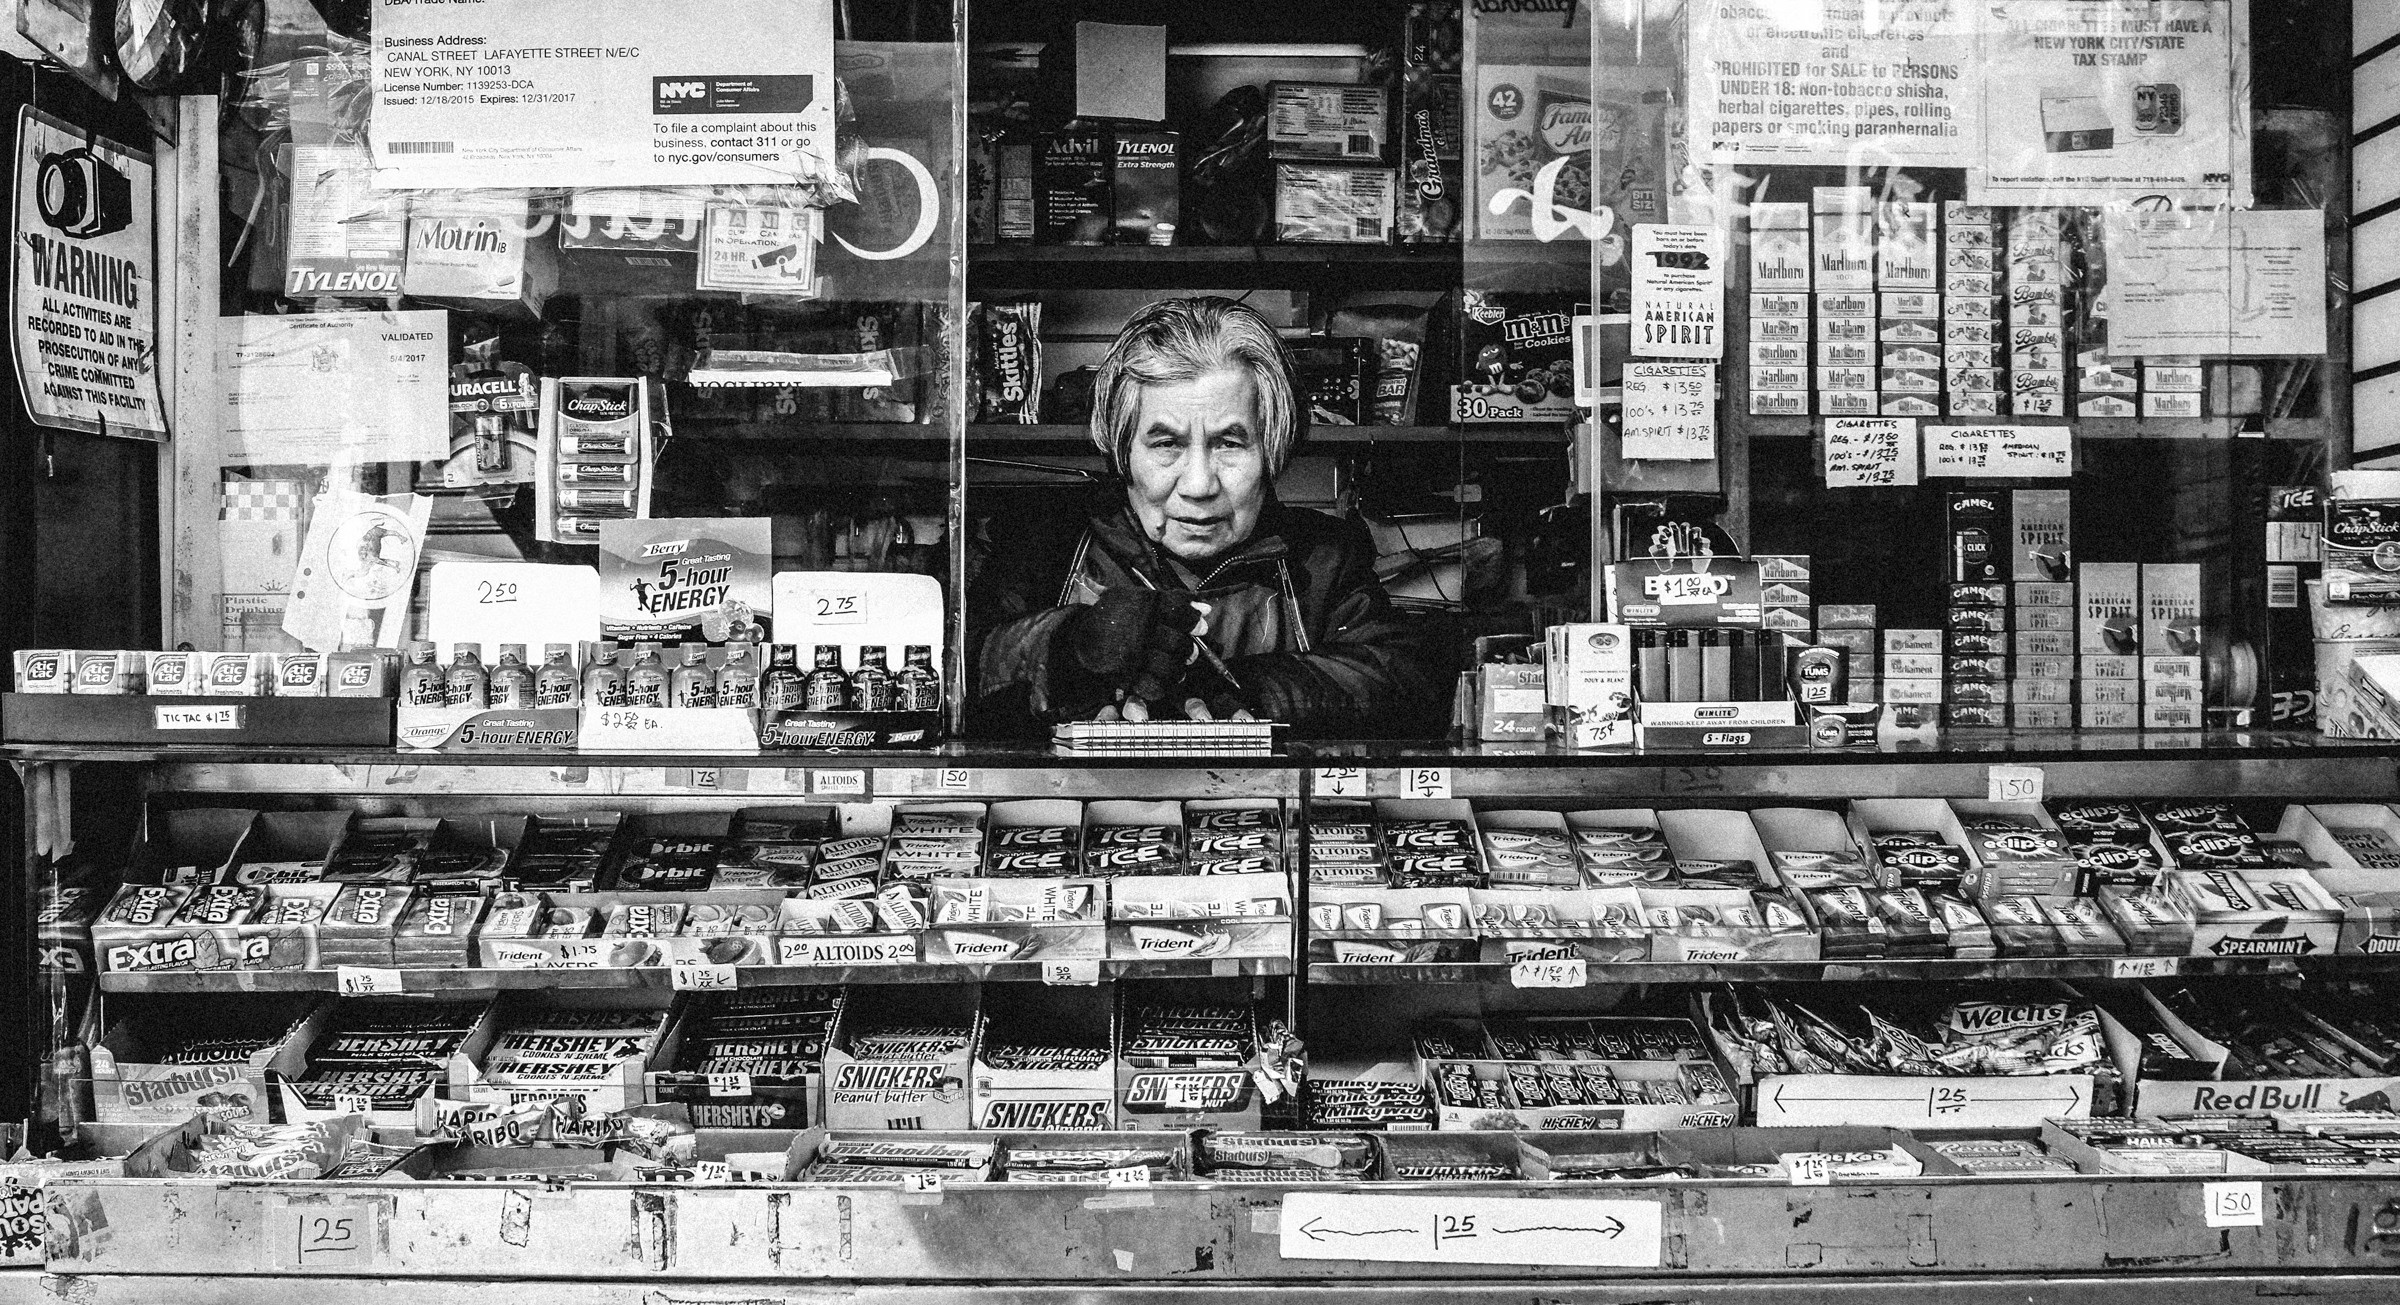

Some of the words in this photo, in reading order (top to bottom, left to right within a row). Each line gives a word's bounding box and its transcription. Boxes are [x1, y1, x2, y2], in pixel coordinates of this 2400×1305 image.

[2121, 20, 2161, 33] MUST
[2165, 20, 2199, 33] HAVE
[384, 37, 434, 47] Business
[436, 35, 487, 46] Address:
[2034, 37, 2065, 50] NEW
[2069, 36, 2105, 50] YORK
[2109, 36, 2185, 50] CITY/STATE
[387, 51, 428, 63] CANAL
[431, 50, 478, 61] STREET
[484, 49, 552, 60] LAFAYETTE
[555, 48, 603, 59] STREET
[605, 47, 640, 58] N/E/C
[2073, 53, 2097, 66] TAX
[2101, 53, 2148, 66] STAMP
[384, 67, 412, 78] NEW
[415, 66, 453, 78] YORK,
[456, 66, 474, 76] NY
[477, 65, 511, 75] 10013
[1713, 61, 1801, 76] PROHIBITED
[1830, 64, 1866, 78] SALE
[1892, 64, 1959, 80] PERSONS
[383, 83, 420, 92] License
[423, 82, 464, 91] Number:
[467, 80, 534, 90] 1139253-DCA
[660, 82, 706, 99] NYC
[1720, 80, 1770, 95] UNDER
[1773, 80, 1796, 96] 18:
[1800, 82, 1893, 98] Non-tobacco
[1896, 84, 1949, 100] shisha,
[383, 97, 418, 106] Issued:
[420, 95, 475, 105] 12/18/2015
[480, 94, 519, 106] Expires:
[522, 93, 576, 103] 12/31/2017
[1492, 90, 1517, 108] 42
[1718, 100, 1764, 115] herbal
[1769, 101, 1849, 118] cigarettes,
[1855, 103, 1900, 120] pipes,
[1904, 103, 1952, 120] rolling
[653, 123, 668, 133] To
[671, 122, 688, 133] file
[690, 125, 699, 133] a
[701, 122, 757, 135] complaint
[760, 122, 793, 132] about
[796, 122, 817, 132] this
[1712, 121, 1763, 136] papers
[1786, 120, 1850, 138] smoking
[1855, 121, 1958, 138] paraphernalia
[653, 137, 707, 149] business,
[710, 137, 754, 148] contact
[756, 136, 777, 147] 311
[781, 139, 793, 147] or
[795, 138, 811, 150] go
[1047, 138, 1100, 154] Advil
[1116, 139, 1176, 155] TYLENOL
[653, 152, 665, 163] to
[668, 151, 780, 165] nyc.gov/consumers
[1417, 109, 1446, 200] Grandma's
[1117, 160, 1138, 169] Extra
[1140, 160, 1176, 169] Strength
[2203, 173, 2230, 184] NYC
[416, 219, 500, 254] Motrin
[1758, 258, 1804, 280] Marlboro
[1821, 253, 1868, 272] Marlboro
[31, 232, 139, 312] WARNING
[291, 266, 399, 294] TYLENOL
[42, 297, 60, 314] ALL
[63, 301, 112, 327] ACTIVITIES
[114, 314, 132, 330] ARE
[1473, 307, 1504, 321] Keebler
[1645, 301, 1714, 311] NATURAL
[1645, 310, 1715, 323] AMERICAN
[28, 315, 82, 340] RECORDED
[84, 327, 97, 343] TO
[100, 330, 115, 347] AID
[116, 334, 126, 349] IN
[128, 336, 146, 353] THE
[381, 332, 434, 342] VALIDATED
[1525, 334, 1571, 349] Cookies
[1645, 324, 1714, 345] SPIRIT
[38, 339, 105, 365] PROSECUTION
[107, 351, 119, 367] OF
[121, 355, 139, 372] ANY
[389, 354, 427, 363] 5/4/2017
[1002, 320, 1022, 402] Skittles
[47, 361, 79, 381] CRIME
[81, 367, 135, 390] COMMITTED
[1634, 366, 1707, 377] CIGARETTES
[43, 381, 84, 402] AGAINST
[85, 388, 107, 406] THIS
[109, 392, 147, 411] FACILITY
[567, 399, 628, 413] ChapStick
[1458, 398, 1488, 418] 30
[1490, 407, 1522, 418] Pack
[1835, 419, 1898, 430] CIGARETTES
[1851, 462, 1882, 471] SPIRIT
[1953, 499, 1995, 511] CAMEL
[2283, 489, 2315, 508] ICE
[2333, 521, 2400, 535] ChapStick
[2020, 532, 2064, 545] SPIRIT
[650, 542, 685, 557] Berry
[1967, 543, 1987, 552] CLICK
[681, 556, 703, 566] Great
[704, 552, 731, 563] Tasting
[657, 559, 732, 590] 5-hour
[649, 584, 731, 613] ENERGY
[1803, 666, 1830, 677] TUMS
[163, 713, 182, 723] TIC
[183, 713, 202, 723] TAC
[1697, 709, 1733, 718] WINLITE
[410, 724, 447, 738] Orange
[460, 724, 516, 745] 5-hour
[515, 730, 574, 744] ENERGY
[1492, 719, 1515, 734] 24
[1515, 725, 1537, 734] count
[1721, 733, 1746, 744] Flags
[820, 775, 858, 786] ALTOIDS
[2057, 802, 2132, 823] eclipse
[899, 824, 974, 835] WHITE
[649, 841, 715, 856] Orbit
[2178, 832, 2255, 856] eclipse
[1401, 855, 1468, 872] ICE
[812, 876, 871, 898] ALTOIDS
[108, 937, 196, 971] Extra
[496, 949, 544, 961] Trident
[2219, 938, 2307, 956] SPEARMINT
[1342, 951, 1396, 963] Trident
[1959, 1006, 2063, 1030] Welch's
[836, 1064, 944, 1092] SNICKERS
[123, 1066, 243, 1108] Starburst
[833, 1090, 880, 1105] Peanut
[882, 1089, 928, 1104] butter
[2194, 1085, 2257, 1111] Red
[2260, 1083, 2322, 1110] Bull
[694, 1103, 771, 1126] HERSHEY'S
[1680, 1112, 1736, 1128] HI-CHEW
[555, 1114, 624, 1135] HARIBO
[2127, 1136, 2175, 1146] HALLS
